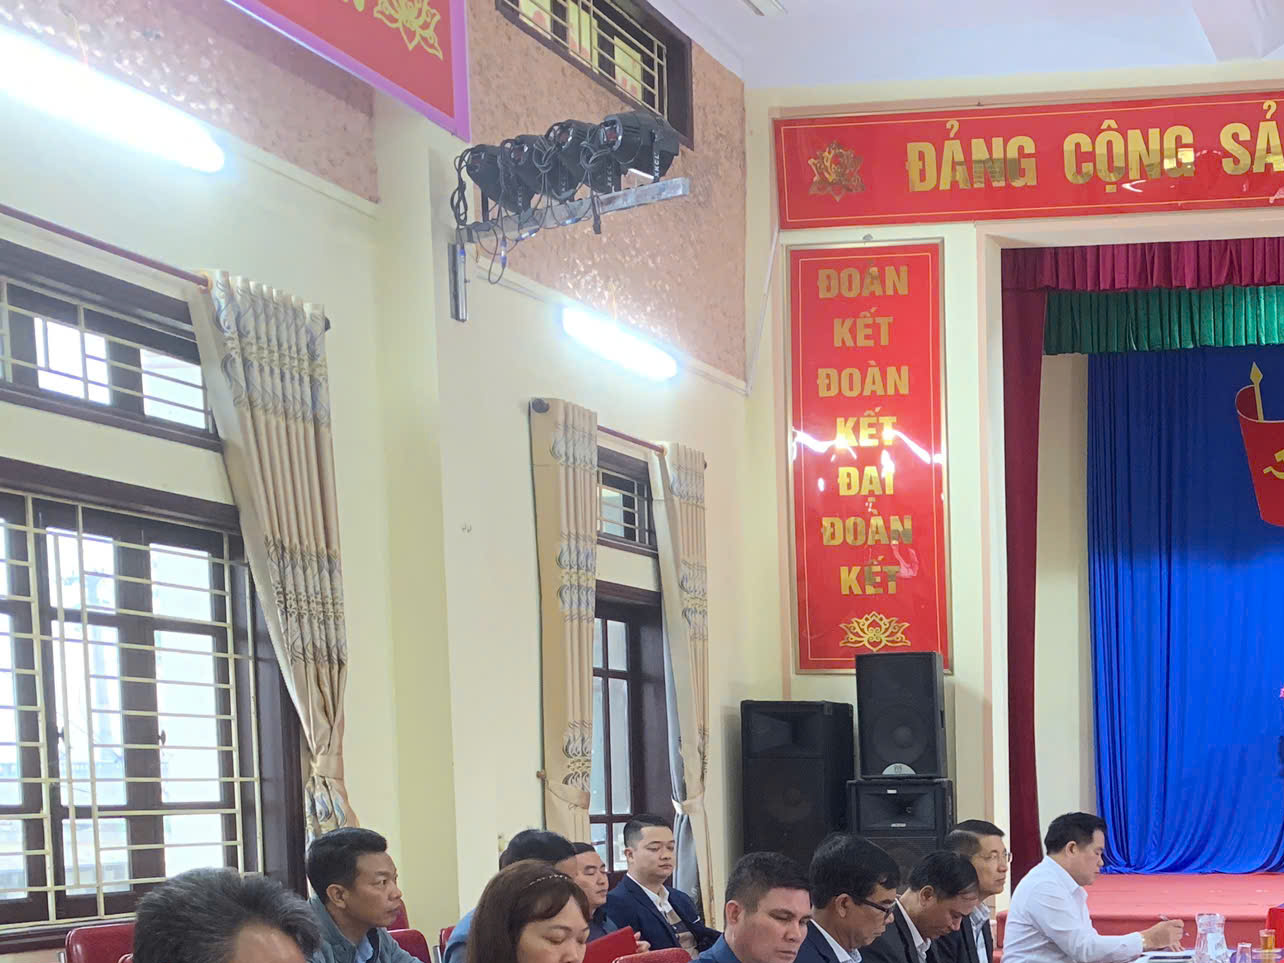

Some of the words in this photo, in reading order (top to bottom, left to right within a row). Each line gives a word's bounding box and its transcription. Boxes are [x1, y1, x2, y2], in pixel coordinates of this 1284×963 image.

[905, 119, 1037, 192] ĐẢNG
[1063, 119, 1195, 193] CỘNG
[816, 260, 910, 299] ĐOÀN
[833, 307, 894, 348] KẾT
[816, 360, 910, 398] ĐOÀN
[835, 406, 897, 448] KẾT
[837, 465, 895, 503] ĐẠI
[820, 509, 913, 546] ĐOÀN
[839, 555, 901, 595] KẾT
